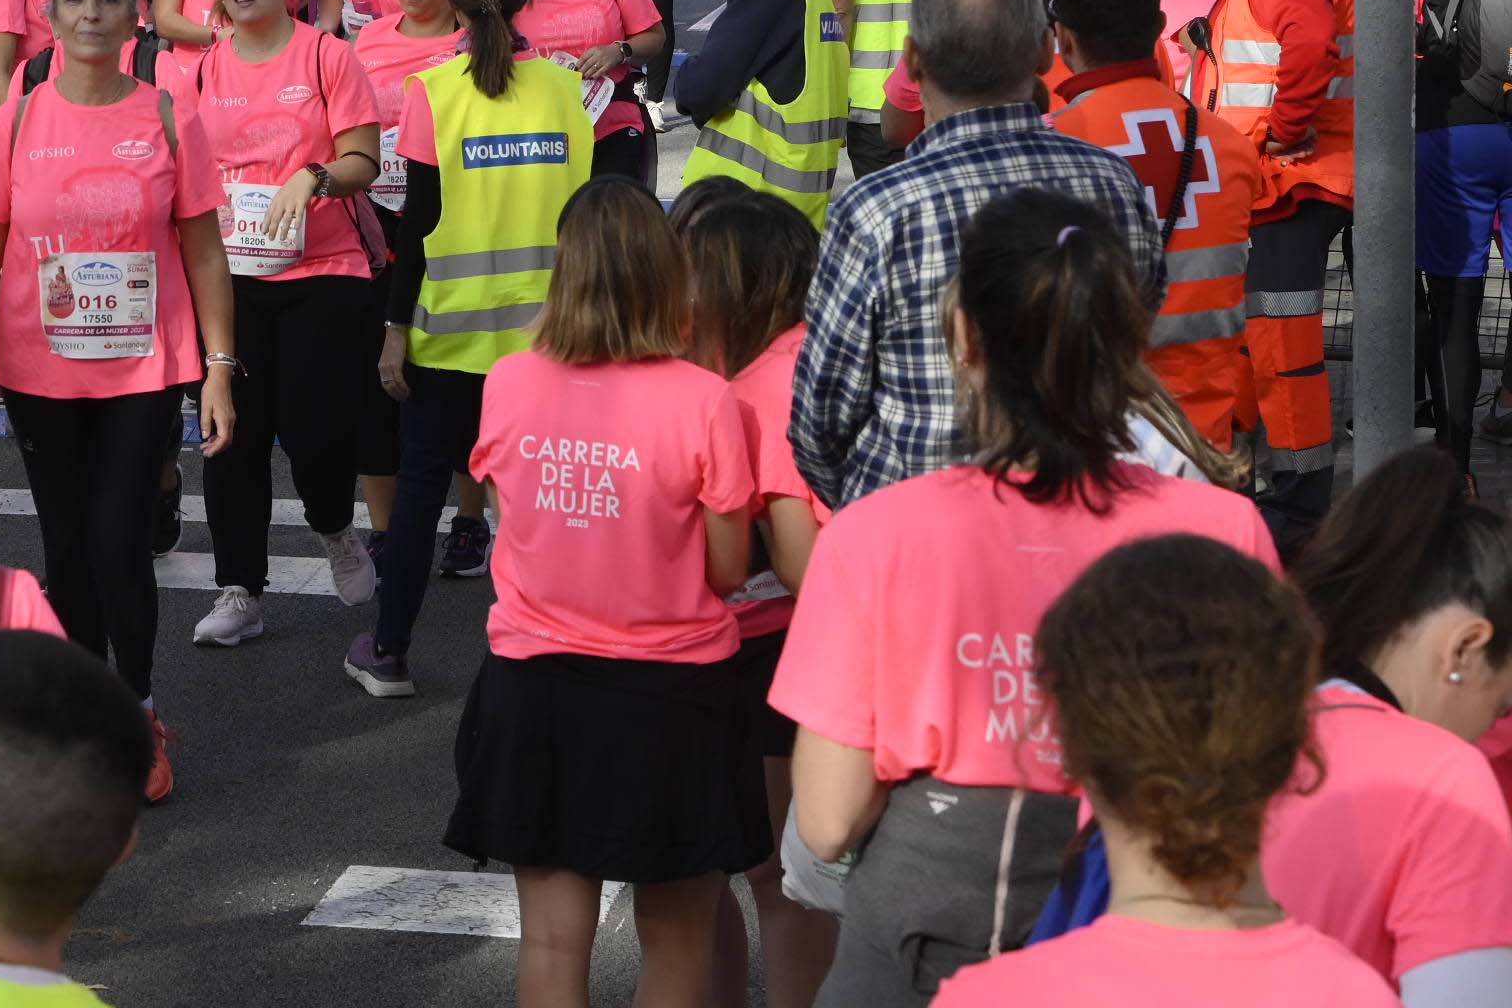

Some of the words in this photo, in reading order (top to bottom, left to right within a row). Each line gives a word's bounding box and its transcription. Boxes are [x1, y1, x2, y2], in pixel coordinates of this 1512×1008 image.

[29, 147, 76, 160] OYSHO
[464, 141, 566, 161] VOLUNTARIS
[238, 220, 265, 234] 01
[30, 234, 65, 260] TU
[240, 237, 266, 246] 18206
[75, 270, 120, 281] ASTURIANA
[79, 295, 117, 310] 016
[83, 315, 113, 323] 17550
[520, 435, 640, 471] CARRERA
[542, 463, 573, 489] DE
[585, 467, 616, 493] LA
[536, 486, 620, 518] MUJER
[994, 670, 1042, 705] DE
